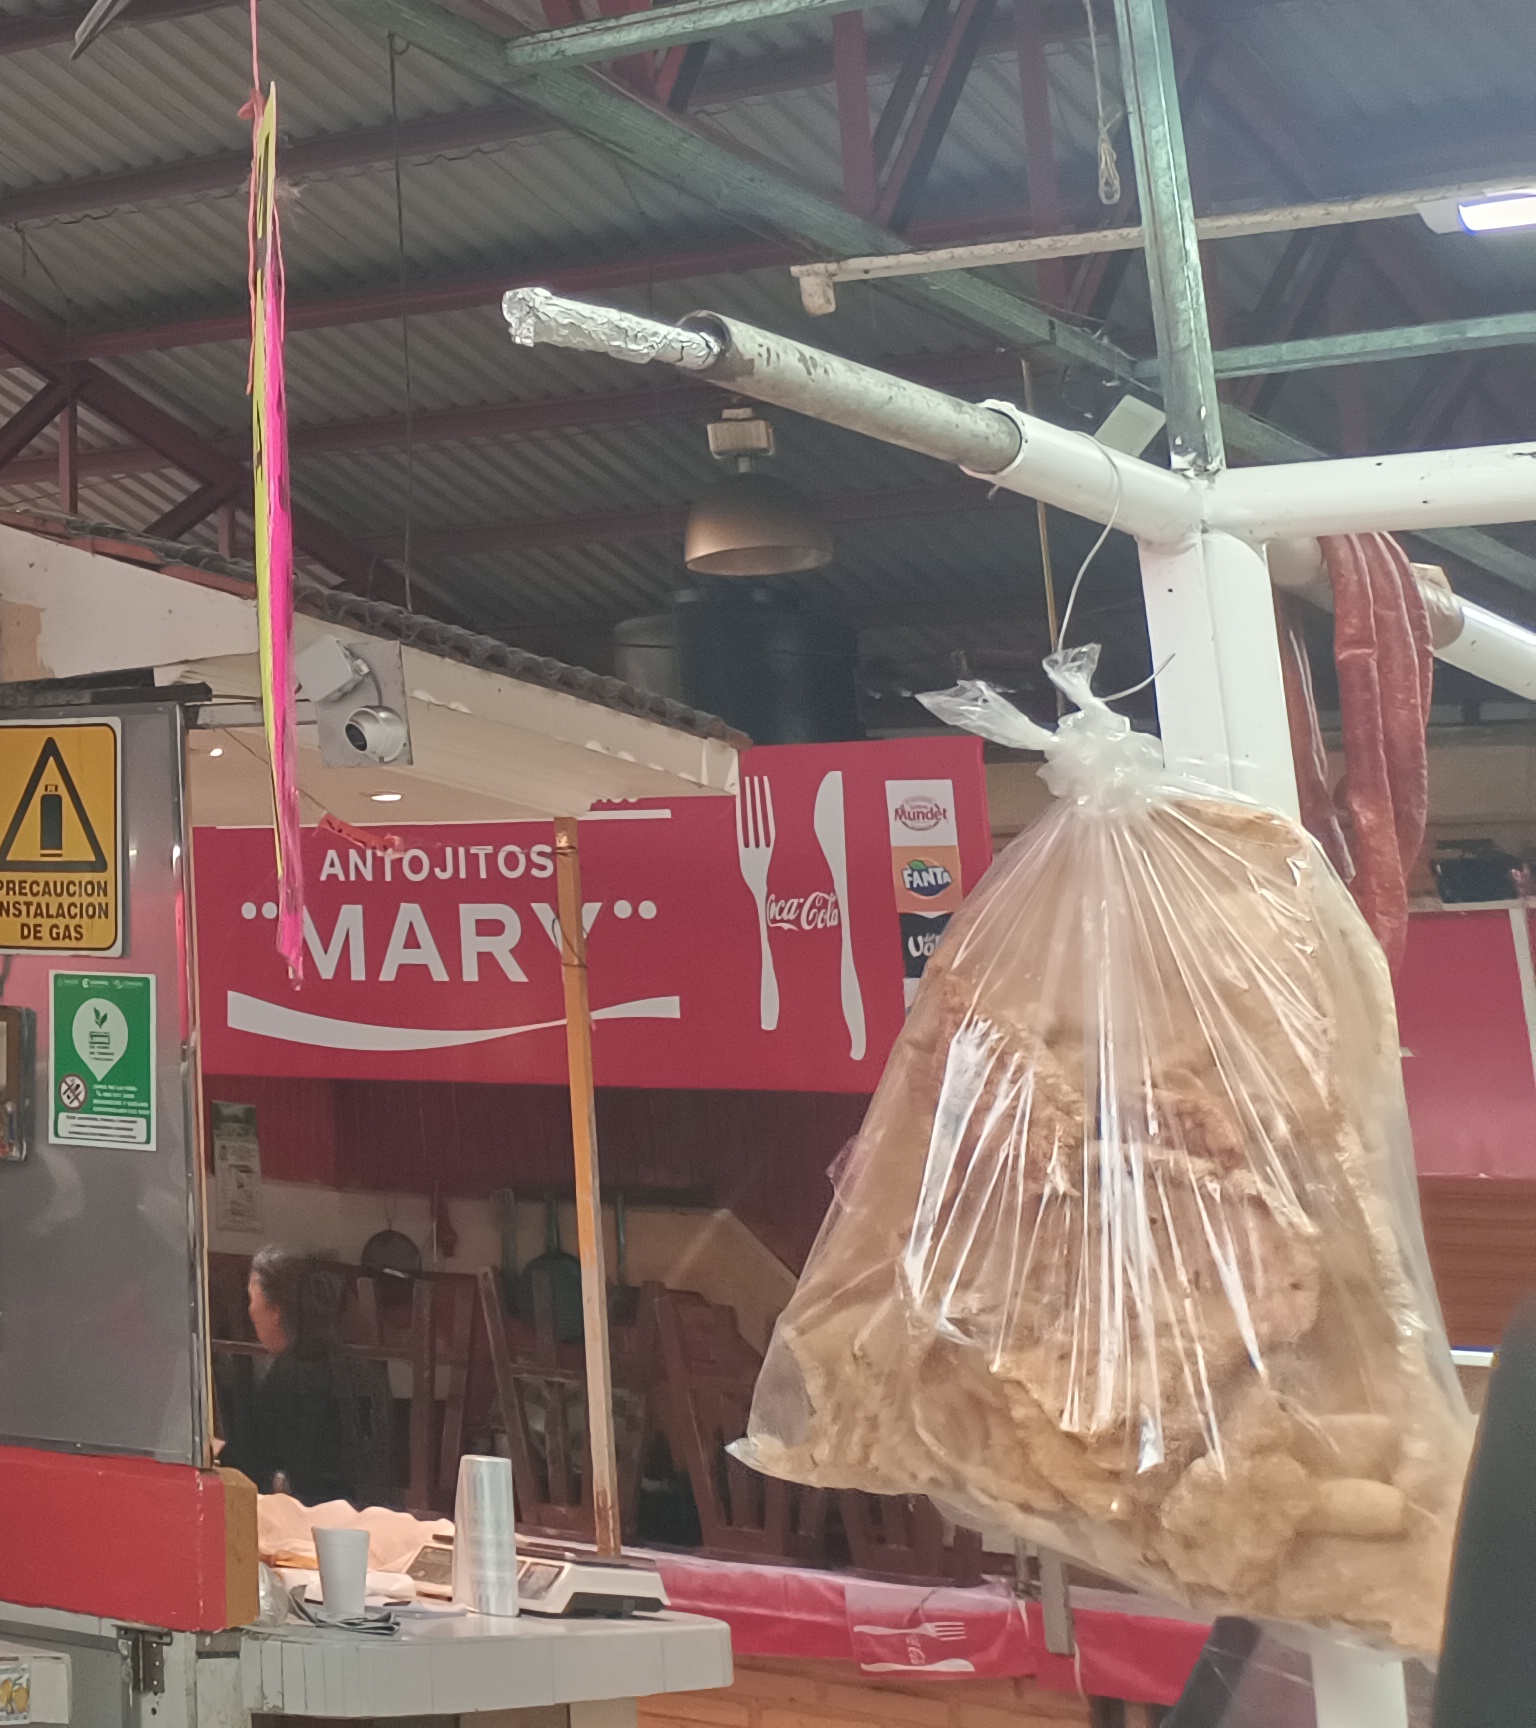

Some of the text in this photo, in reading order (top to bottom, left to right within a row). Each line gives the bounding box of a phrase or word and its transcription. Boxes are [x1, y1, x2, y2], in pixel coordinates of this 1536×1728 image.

[894, 802, 948, 823] Mundet
[319, 843, 555, 882] ANTOJITOS
[902, 866, 952, 890] FANTA
[766, 890, 840, 932] Coca-Cola
[20, 922, 84, 942] DE GAS
